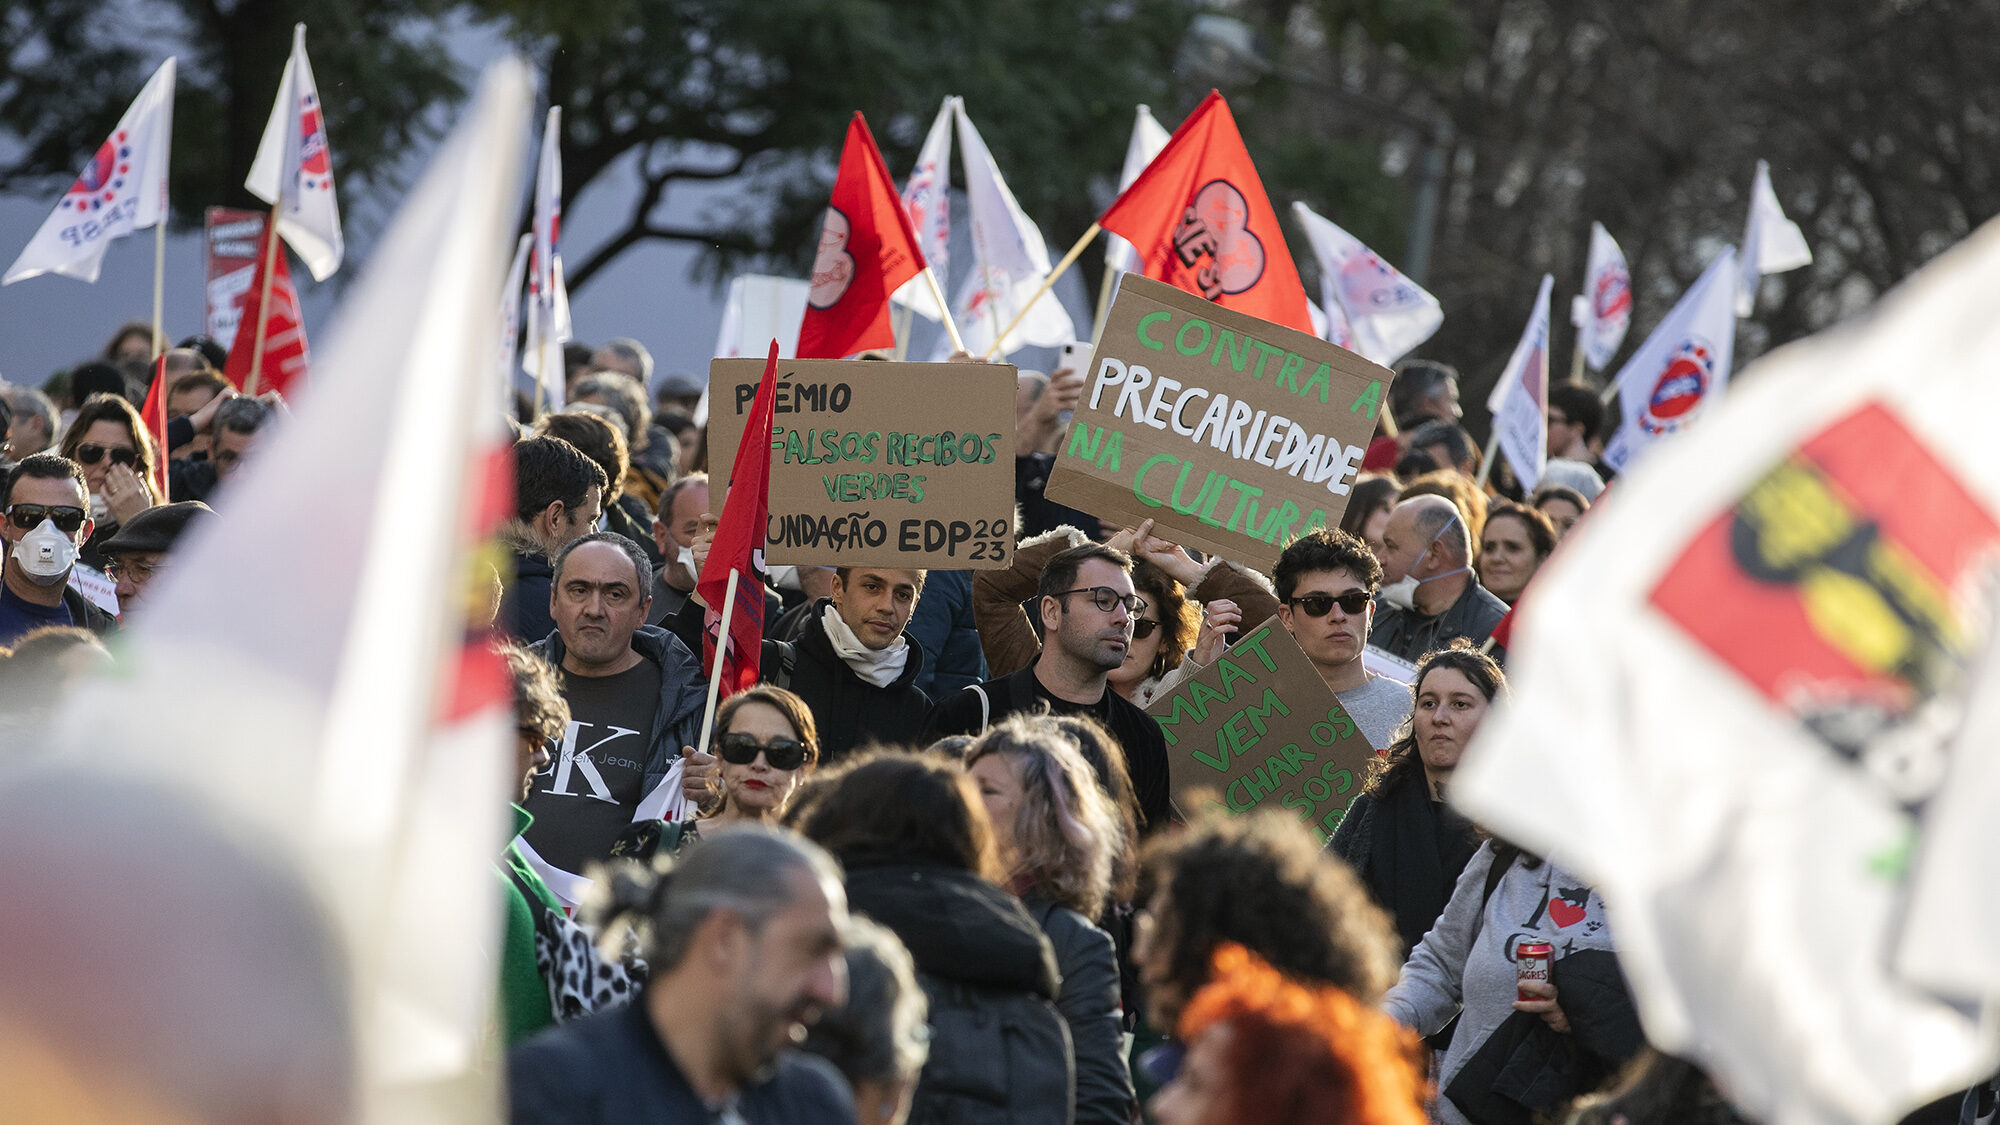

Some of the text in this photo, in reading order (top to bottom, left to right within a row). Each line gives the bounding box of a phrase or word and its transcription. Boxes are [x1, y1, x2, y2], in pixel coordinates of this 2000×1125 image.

[1136, 312, 1381, 419] CONTRA A
[735, 372, 852, 415] PÉMIO
[887, 430, 1002, 466] RECIBOS
[1067, 422, 1124, 473] NA
[1089, 358, 1365, 497] PRECARIEDADE
[822, 472, 927, 503] VERDES
[767, 511, 1008, 556] UNDAÇÃO EDP 20
[968, 541, 1005, 561] 23
[1152, 627, 1278, 746] MAAT
[1191, 688, 1292, 773] VEM
[599, 753, 643, 773] Jeans
[1225, 706, 1356, 814] CHAR OS
[1281, 760, 1353, 822] SOS
[1517, 969, 1548, 981] SAGRES
